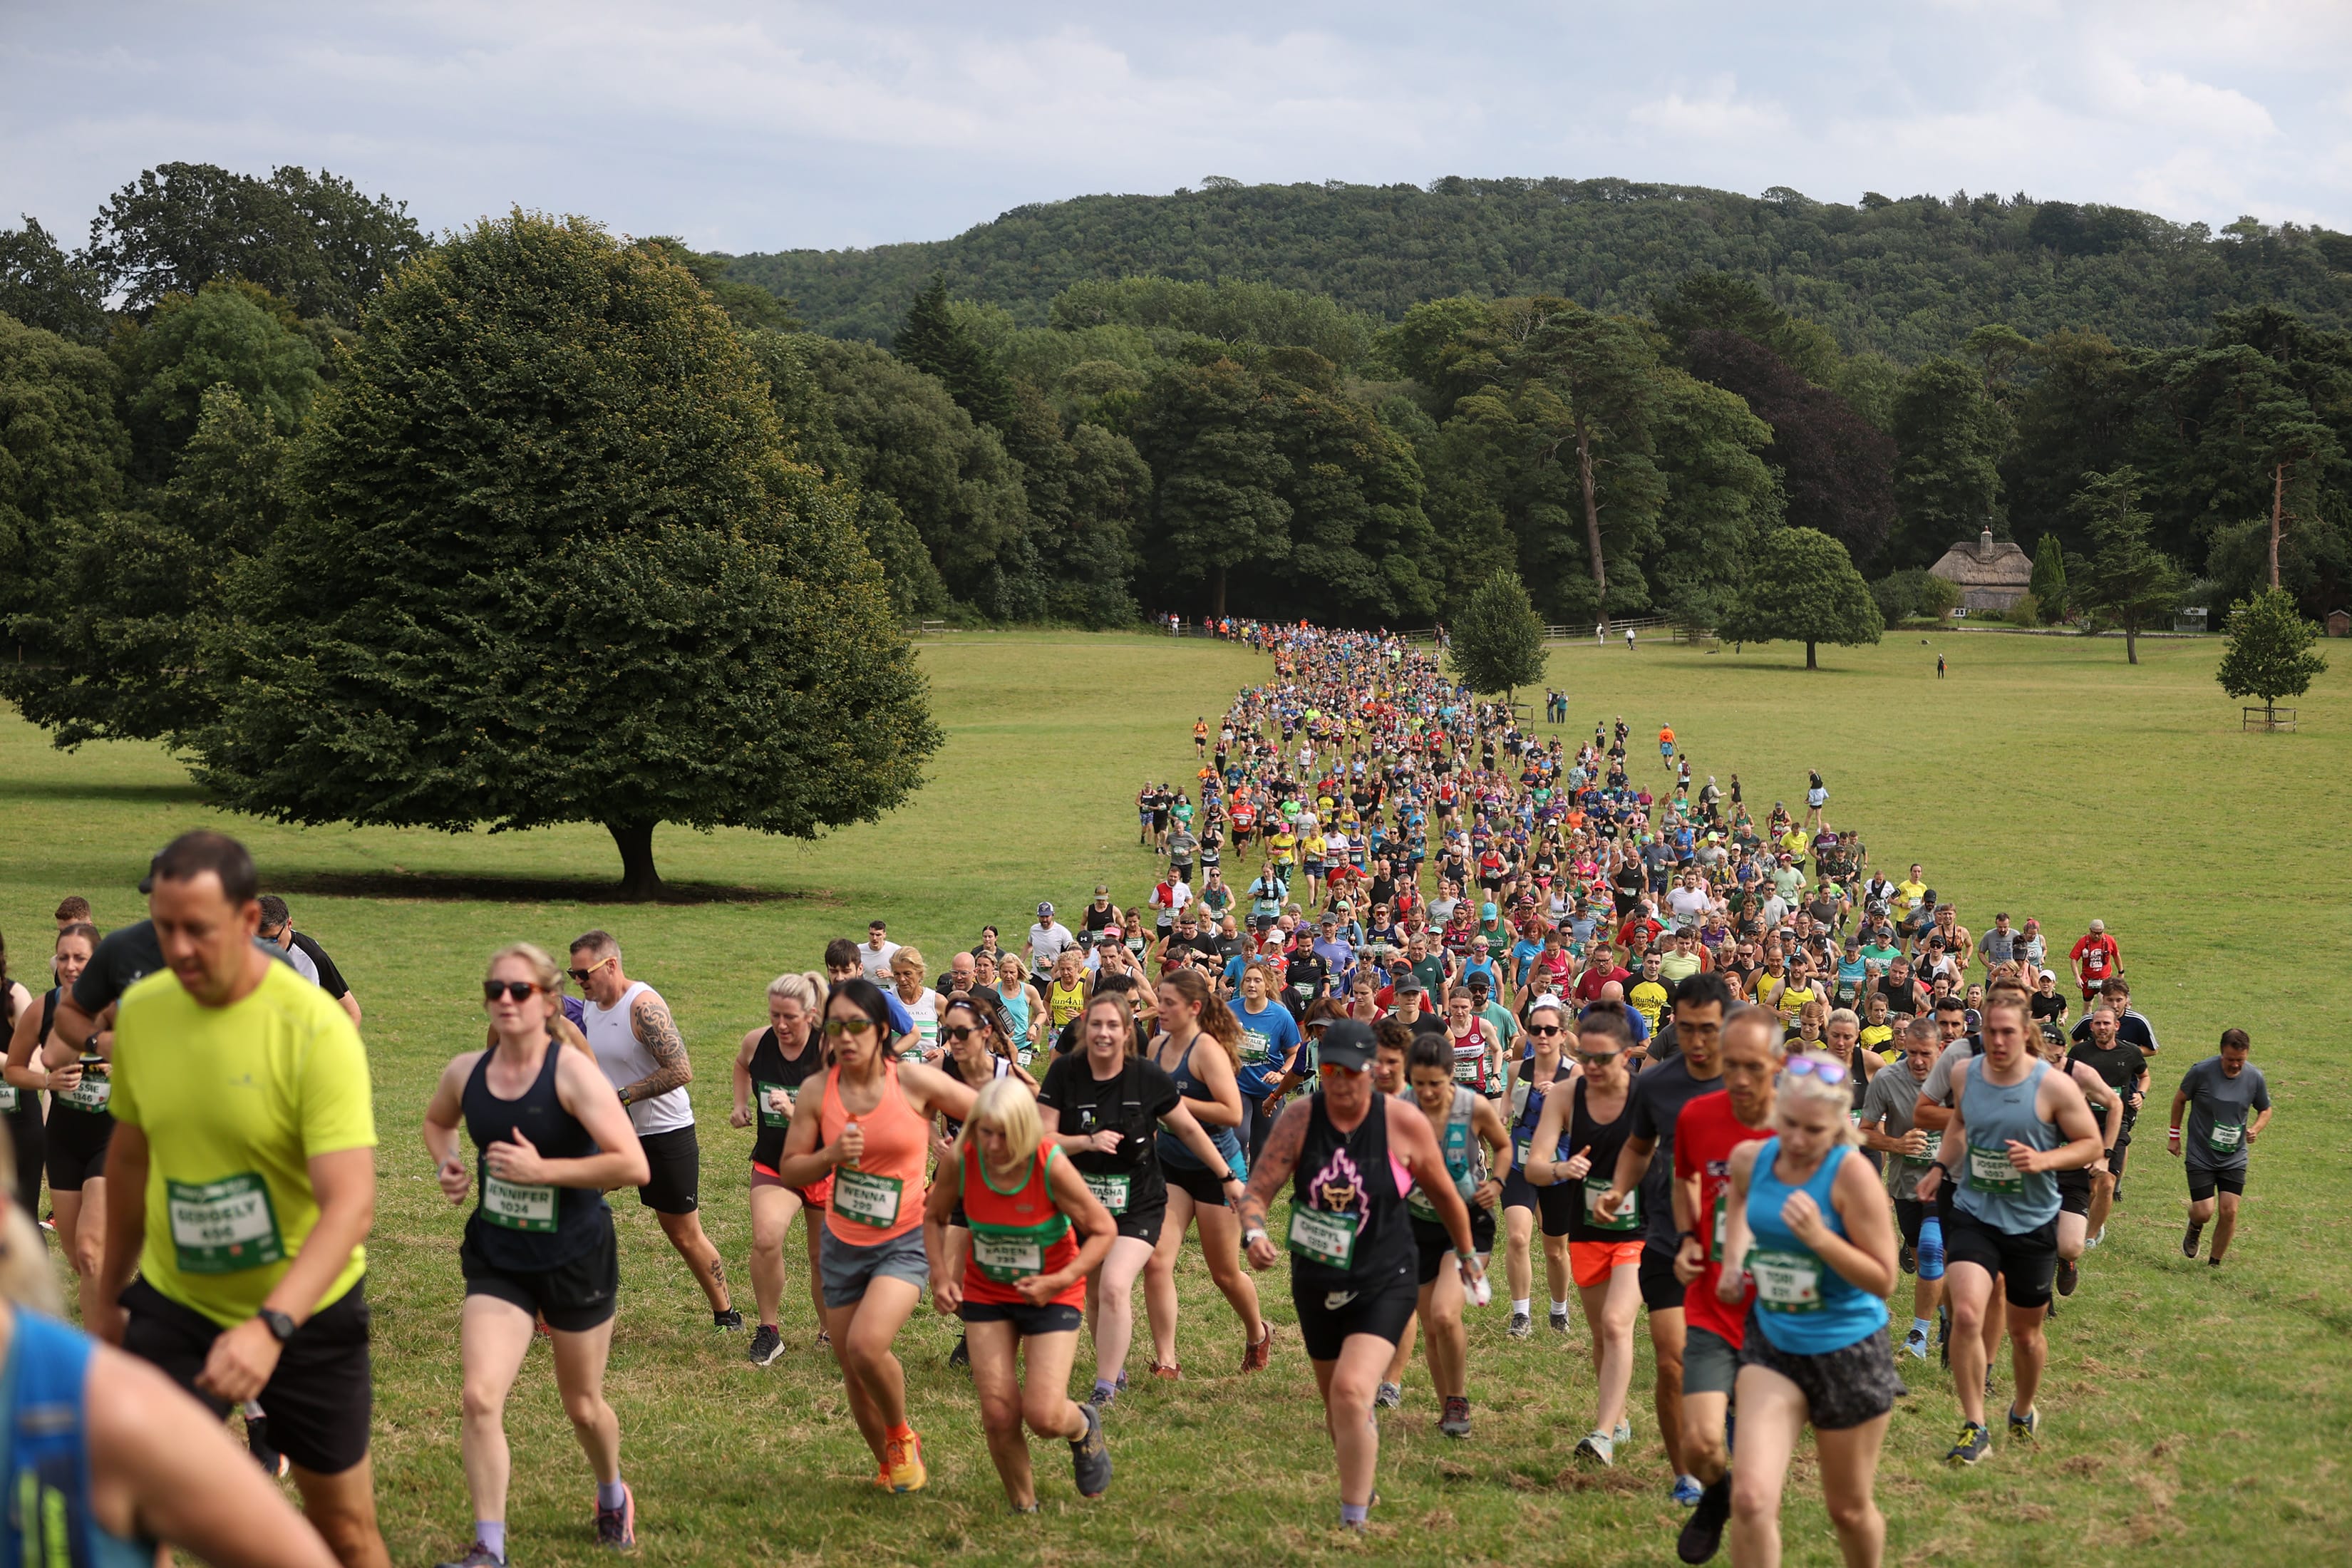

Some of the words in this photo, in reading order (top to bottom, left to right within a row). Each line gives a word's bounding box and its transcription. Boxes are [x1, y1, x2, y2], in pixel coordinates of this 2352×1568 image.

[1051, 996, 1084, 1006] Run4All
[1976, 1159, 2012, 1170] JOSEPH
[488, 1183, 549, 1204] JENNIFER
[844, 1185, 886, 1203] WENNA
[1300, 1220, 1340, 1243] CHERYL
[985, 1247, 1028, 1257] KAREN
[1766, 1271, 1794, 1284] TORI
